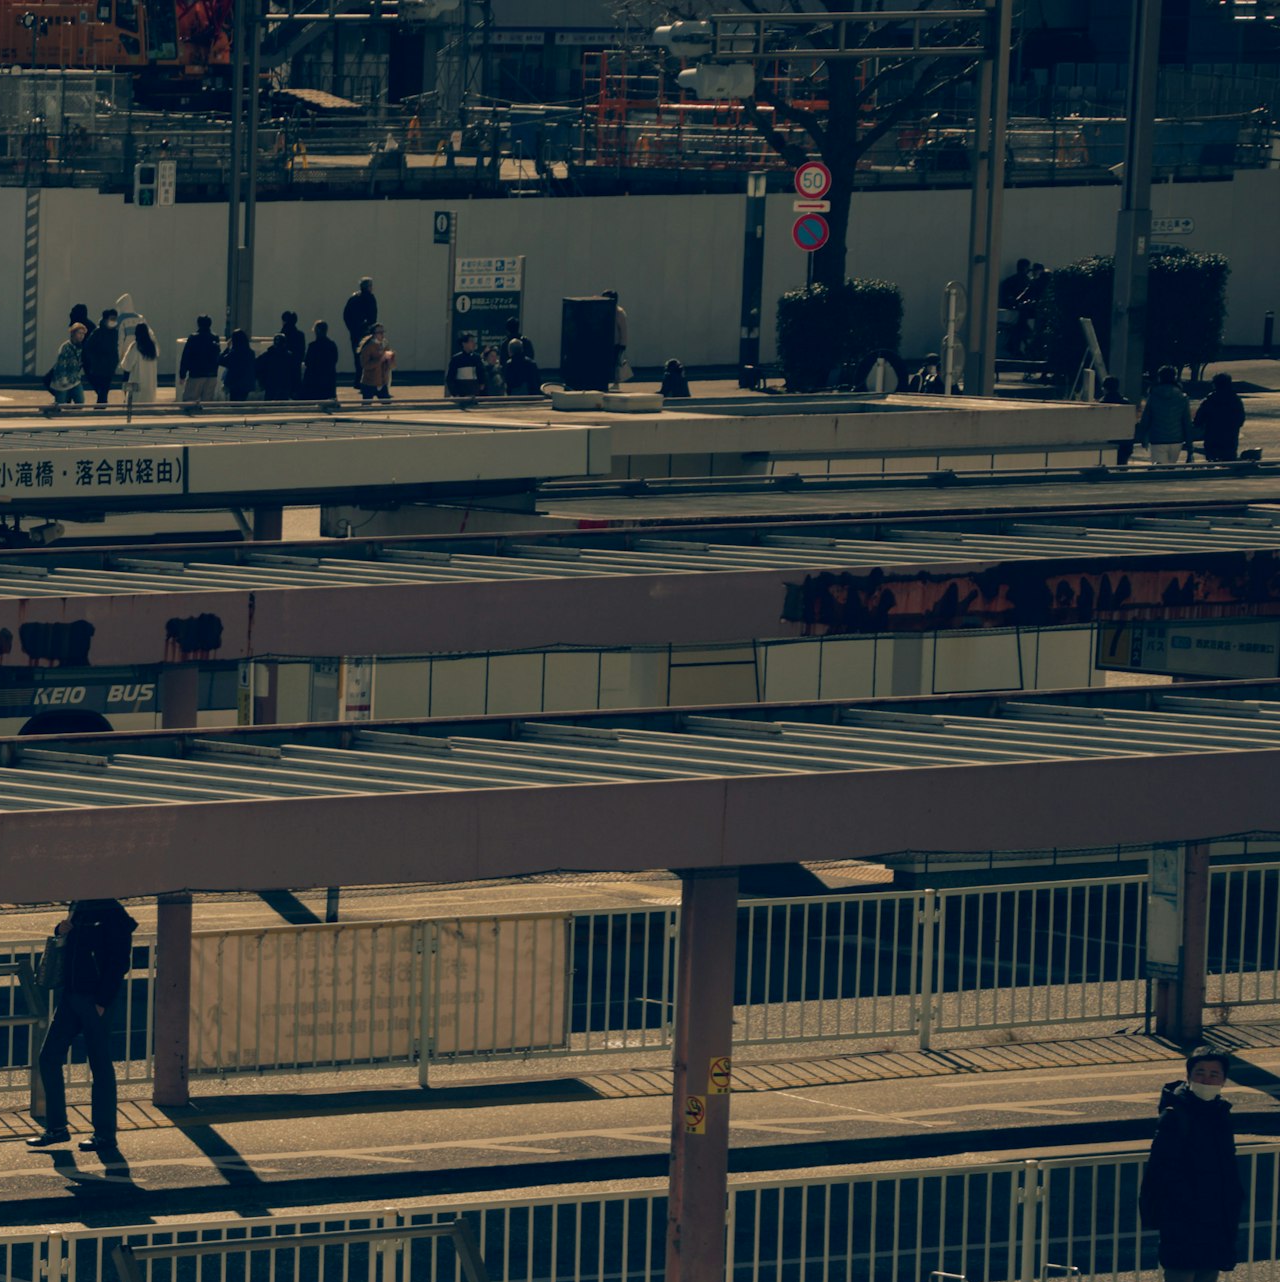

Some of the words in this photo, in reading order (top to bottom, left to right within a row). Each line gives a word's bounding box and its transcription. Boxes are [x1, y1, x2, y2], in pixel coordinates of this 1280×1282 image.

[803, 172, 823, 189] 50
[33, 685, 87, 706] KEIO
[106, 683, 157, 705] BUS
